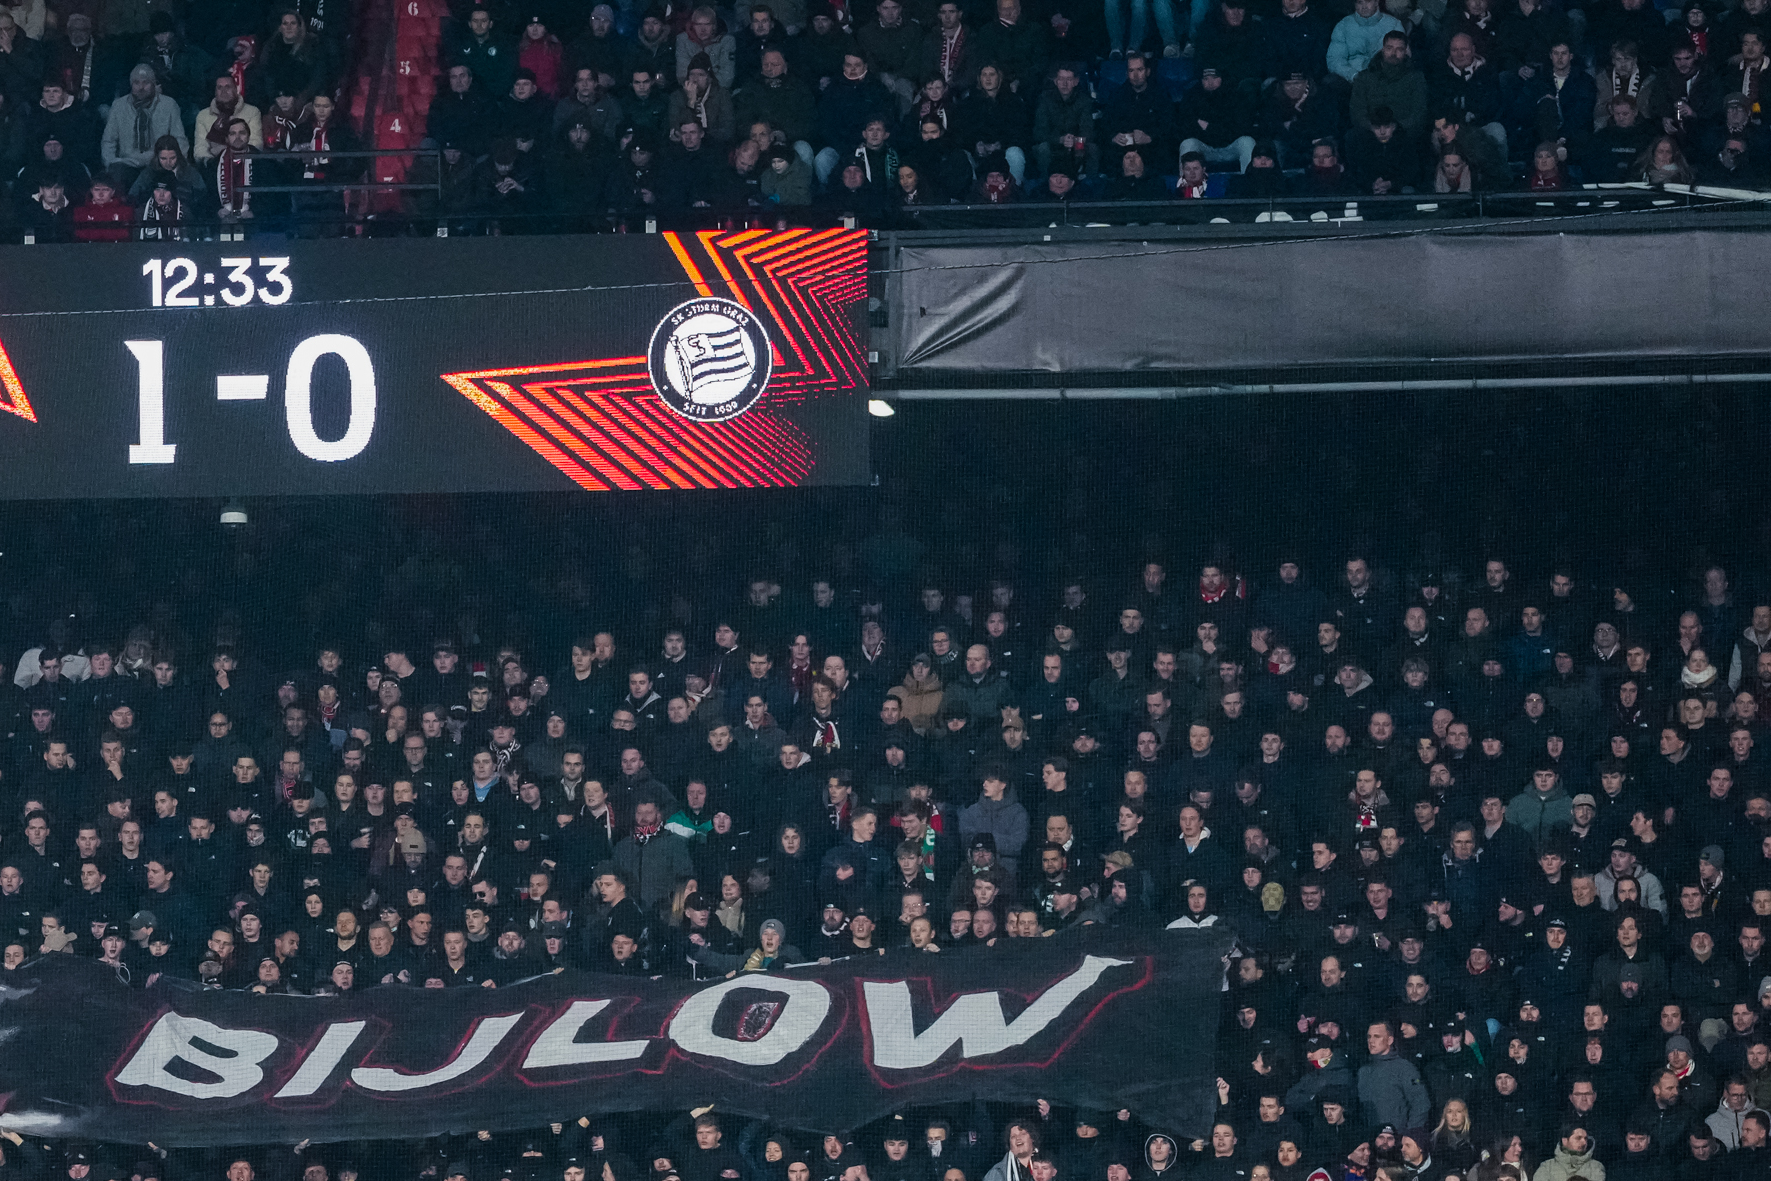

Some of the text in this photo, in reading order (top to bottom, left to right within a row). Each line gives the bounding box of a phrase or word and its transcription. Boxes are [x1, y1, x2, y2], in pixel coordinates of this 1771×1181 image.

[407, 1, 419, 17] 6
[399, 60, 411, 75] 5
[389, 118, 402, 133] 4
[142, 256, 293, 307] 12:33
[115, 954, 1135, 1098] BIJLOW
